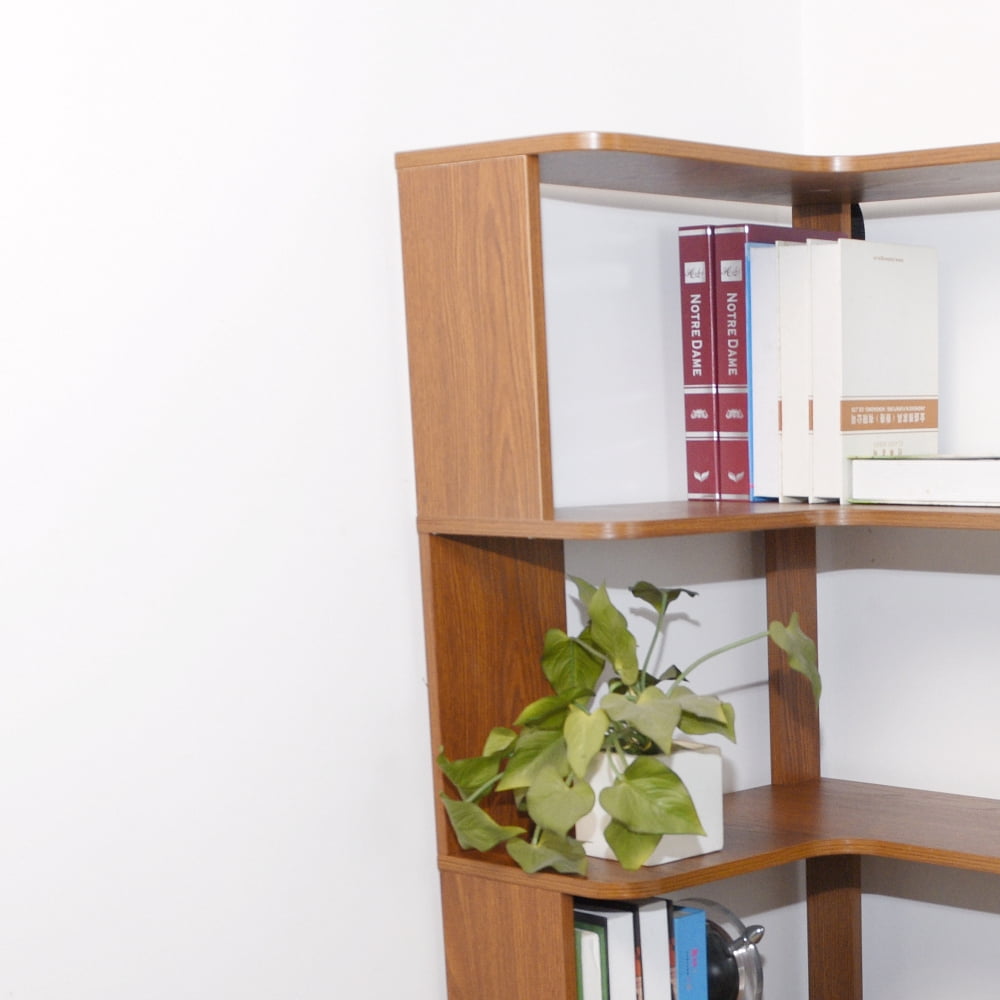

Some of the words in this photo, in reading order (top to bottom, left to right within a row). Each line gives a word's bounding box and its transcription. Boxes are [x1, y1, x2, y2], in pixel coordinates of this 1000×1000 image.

[690, 294, 701, 337] NOTRE
[726, 292, 738, 336] NOTRE
[691, 339, 703, 377] DAME
[727, 339, 739, 376] DAME
